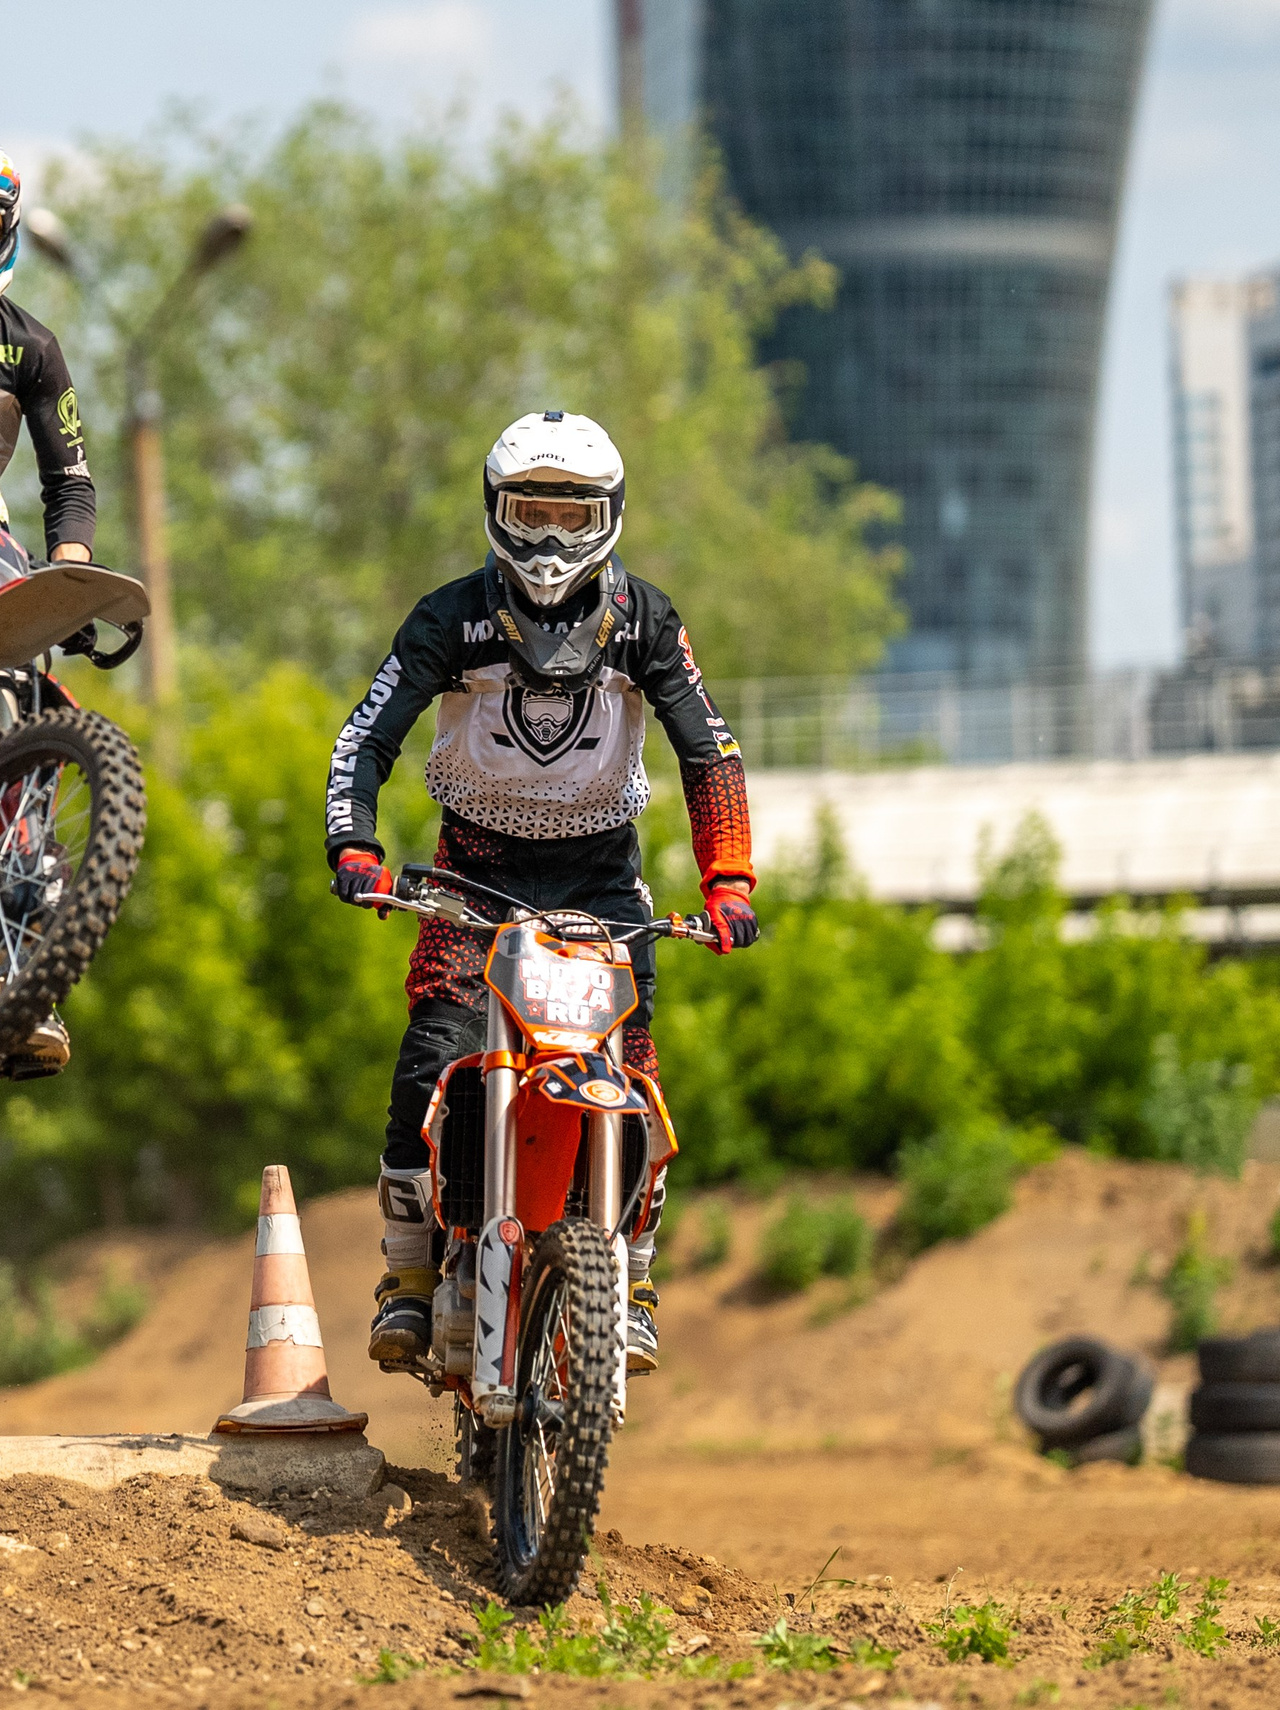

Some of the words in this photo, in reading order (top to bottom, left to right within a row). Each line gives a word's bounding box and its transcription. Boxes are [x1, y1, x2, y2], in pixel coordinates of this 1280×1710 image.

[497, 609, 523, 643] LEATT
[595, 608, 615, 648] LEATT
[546, 1000, 591, 1026] RU
[532, 1029, 599, 1052] KTM
